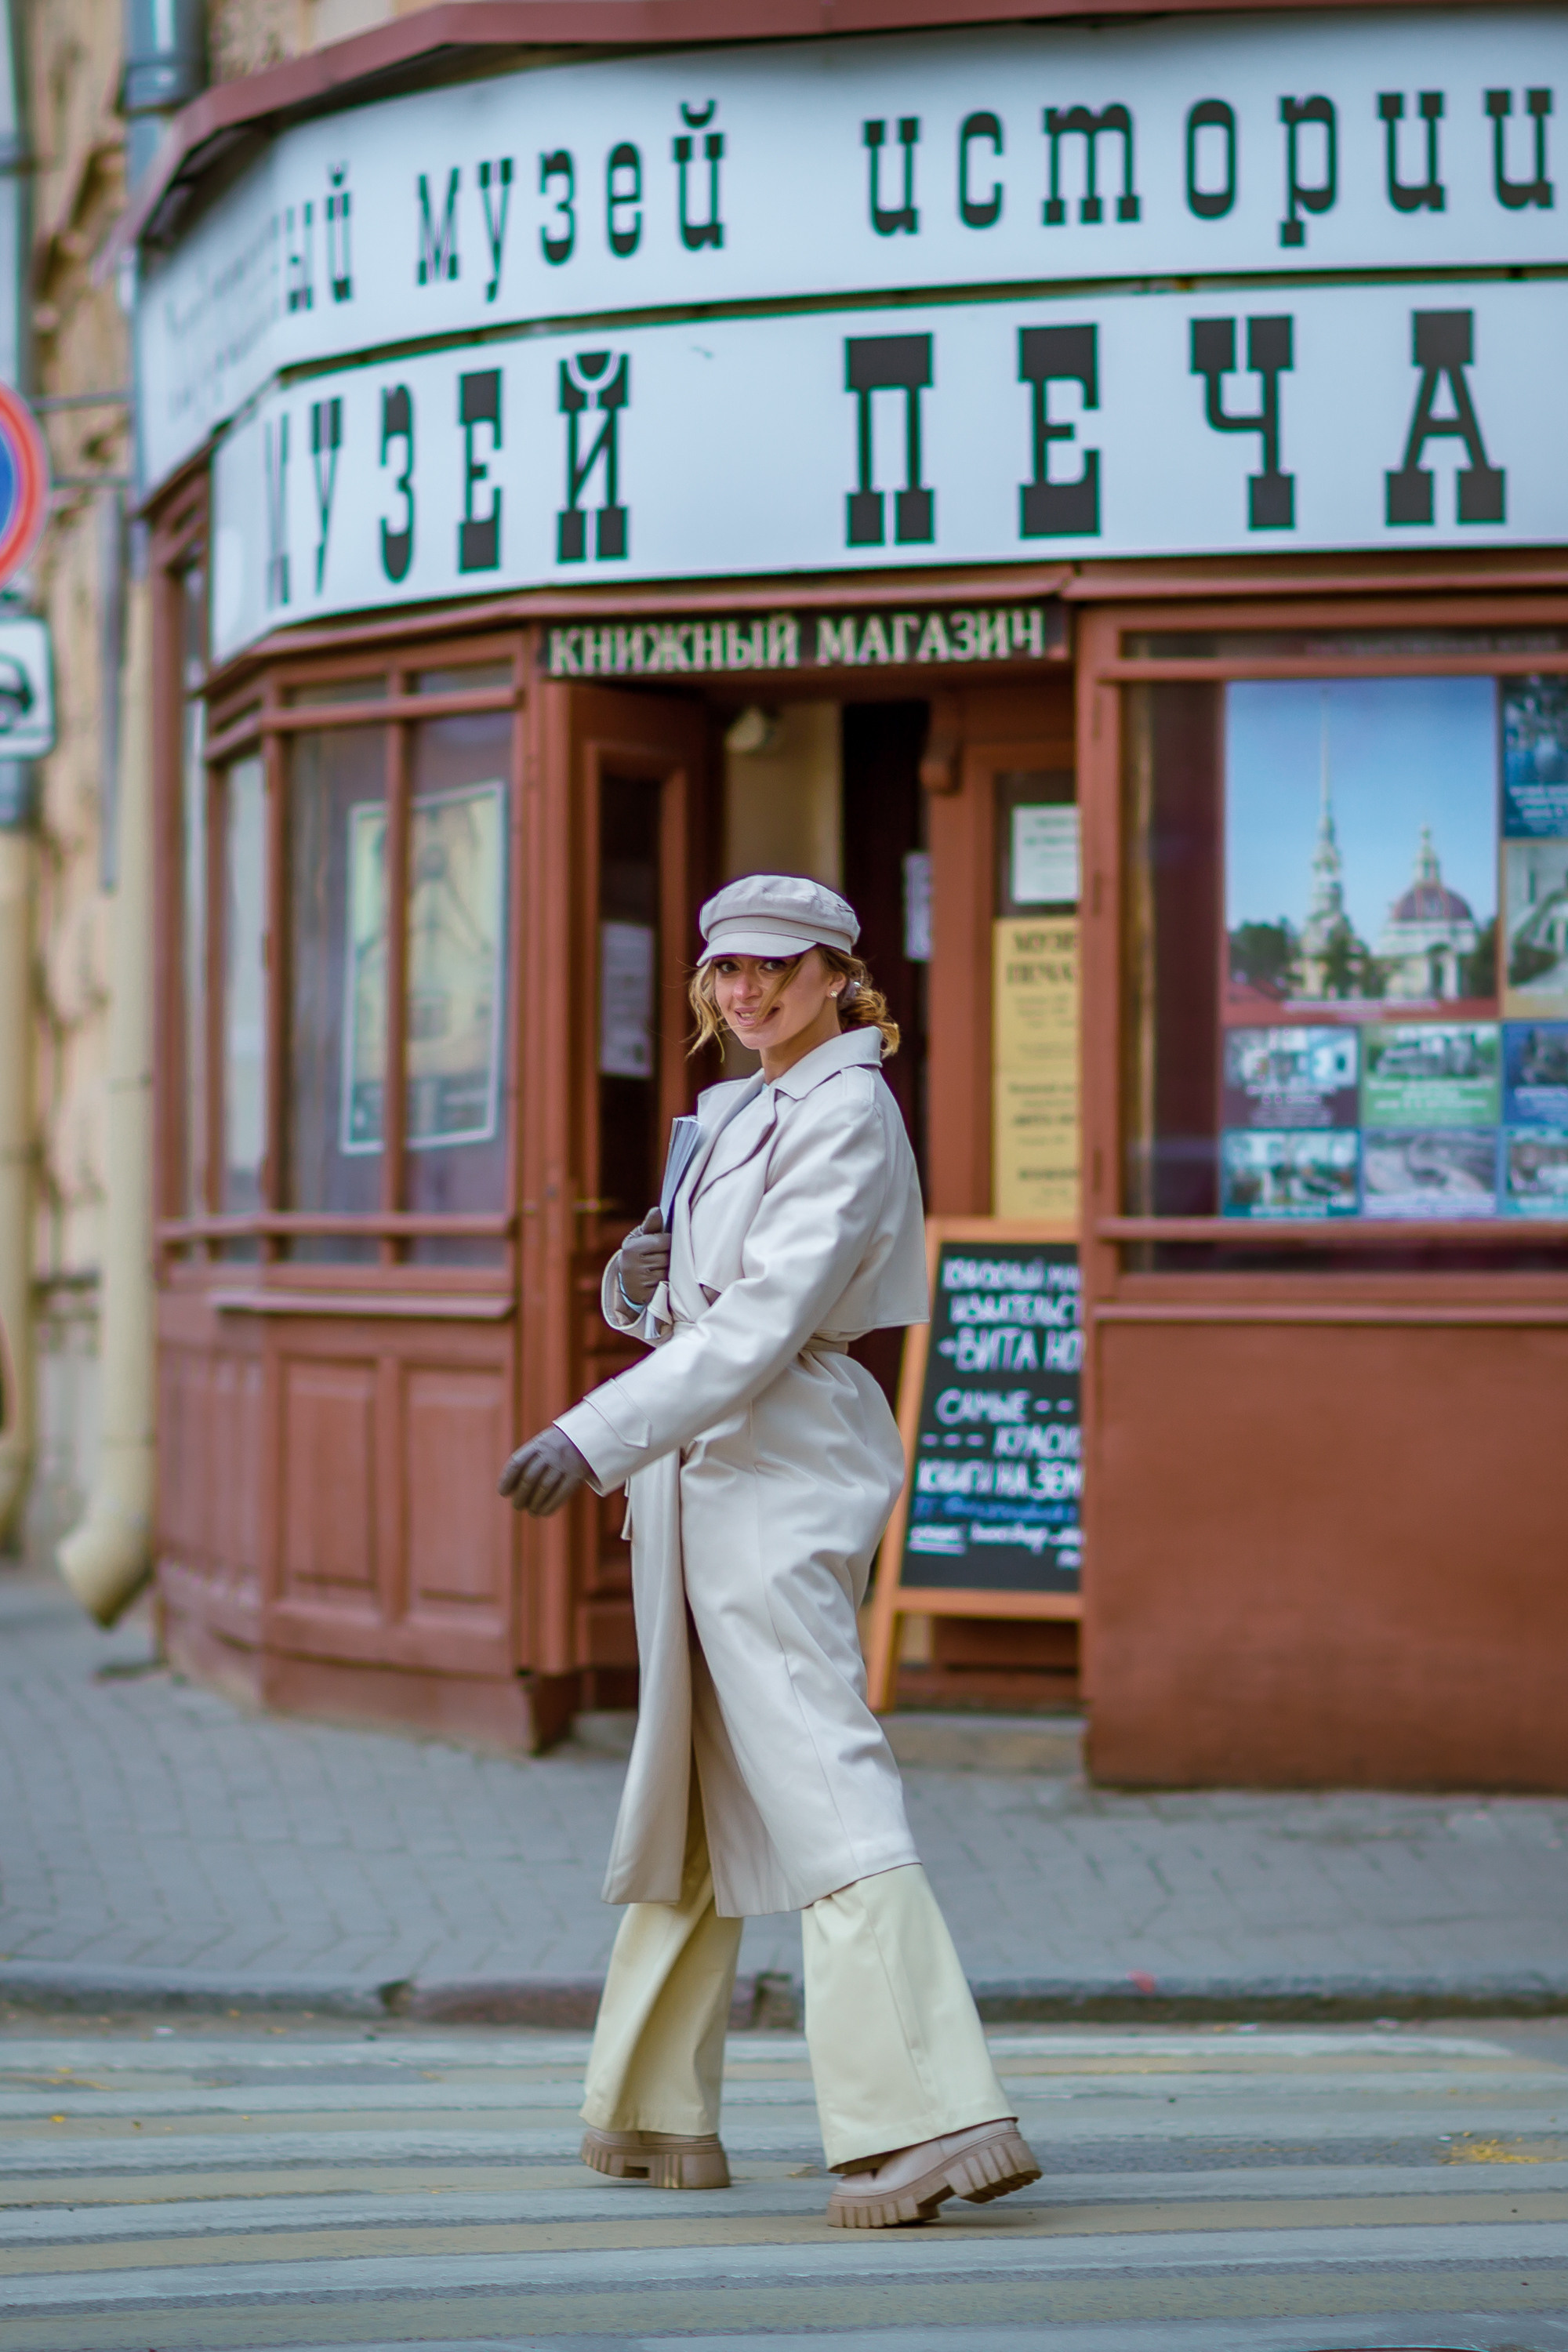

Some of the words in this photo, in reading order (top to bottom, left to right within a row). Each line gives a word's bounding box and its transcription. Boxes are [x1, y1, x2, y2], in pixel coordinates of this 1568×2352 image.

[417, 99, 725, 304] музей
[862, 88, 1555, 248] истории
[265, 350, 629, 613] МУЗЕЙ
[844, 309, 1507, 547] ПЕЧА
[550, 612, 800, 677] КНИЖНЫЙ
